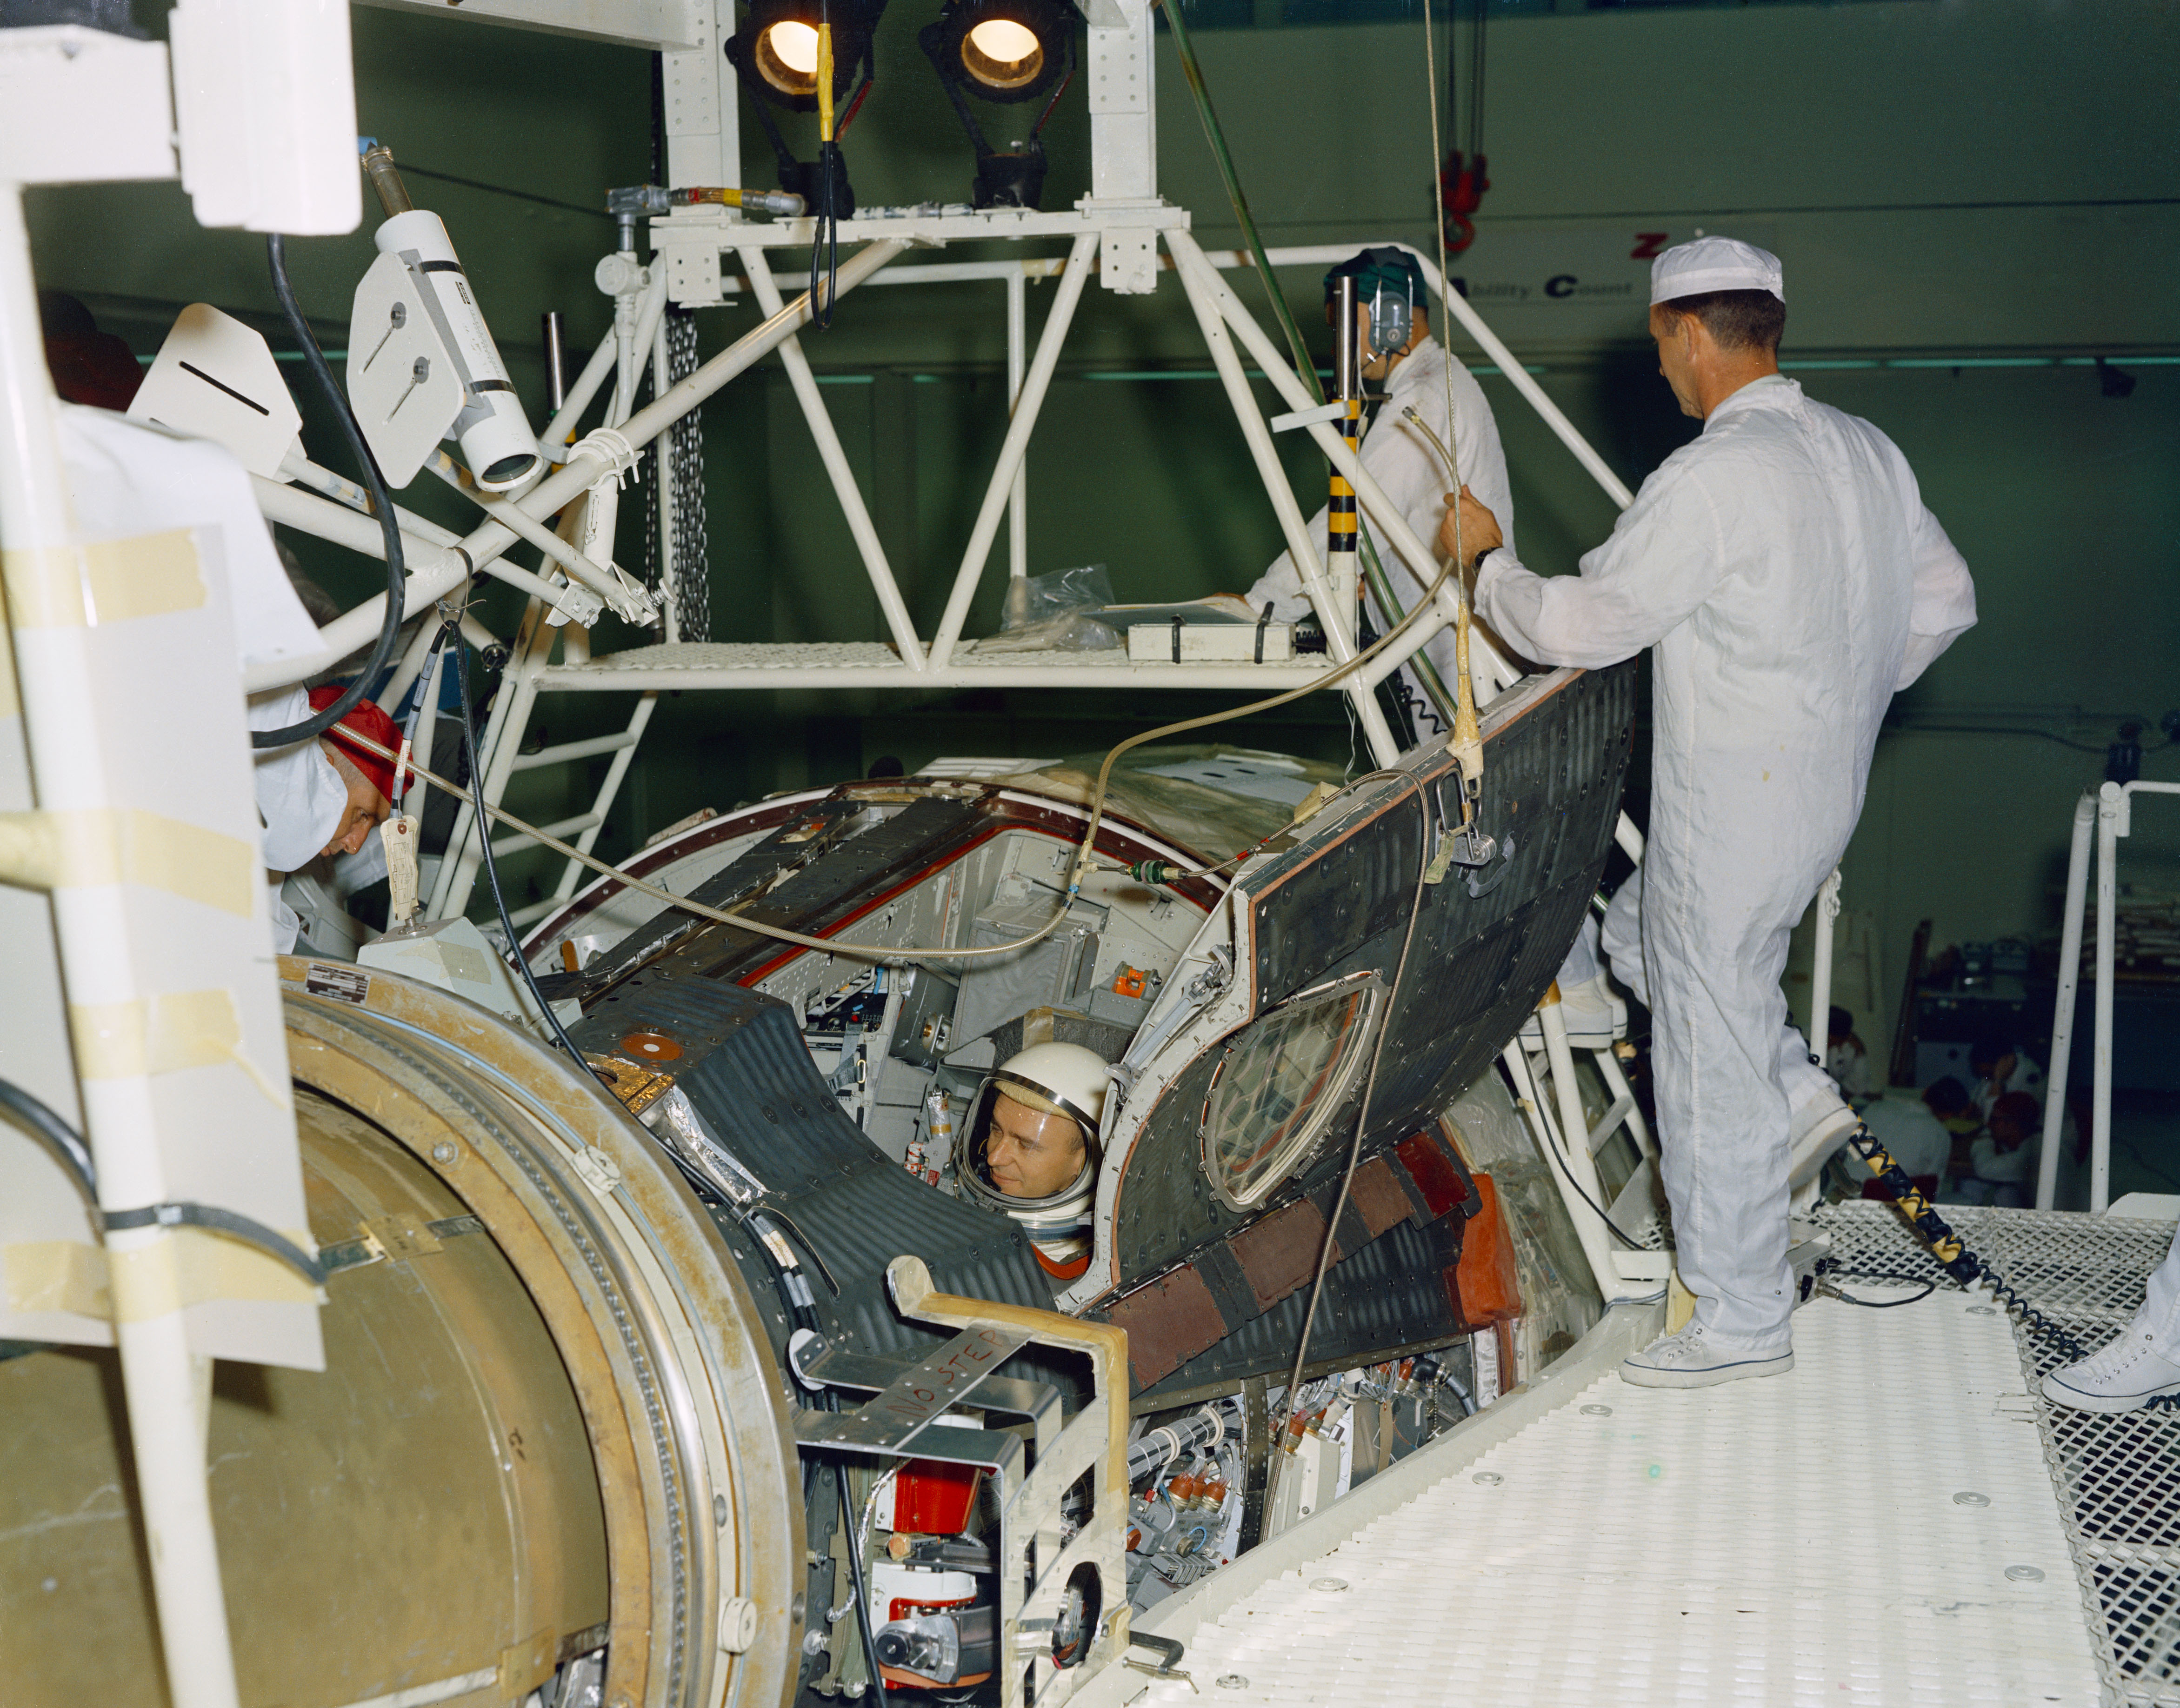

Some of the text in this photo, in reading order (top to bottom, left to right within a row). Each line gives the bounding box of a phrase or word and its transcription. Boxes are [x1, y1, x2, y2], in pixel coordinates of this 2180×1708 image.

[1630, 232, 1669, 260] Z
[886, 1329, 1007, 1418] NO STEP
